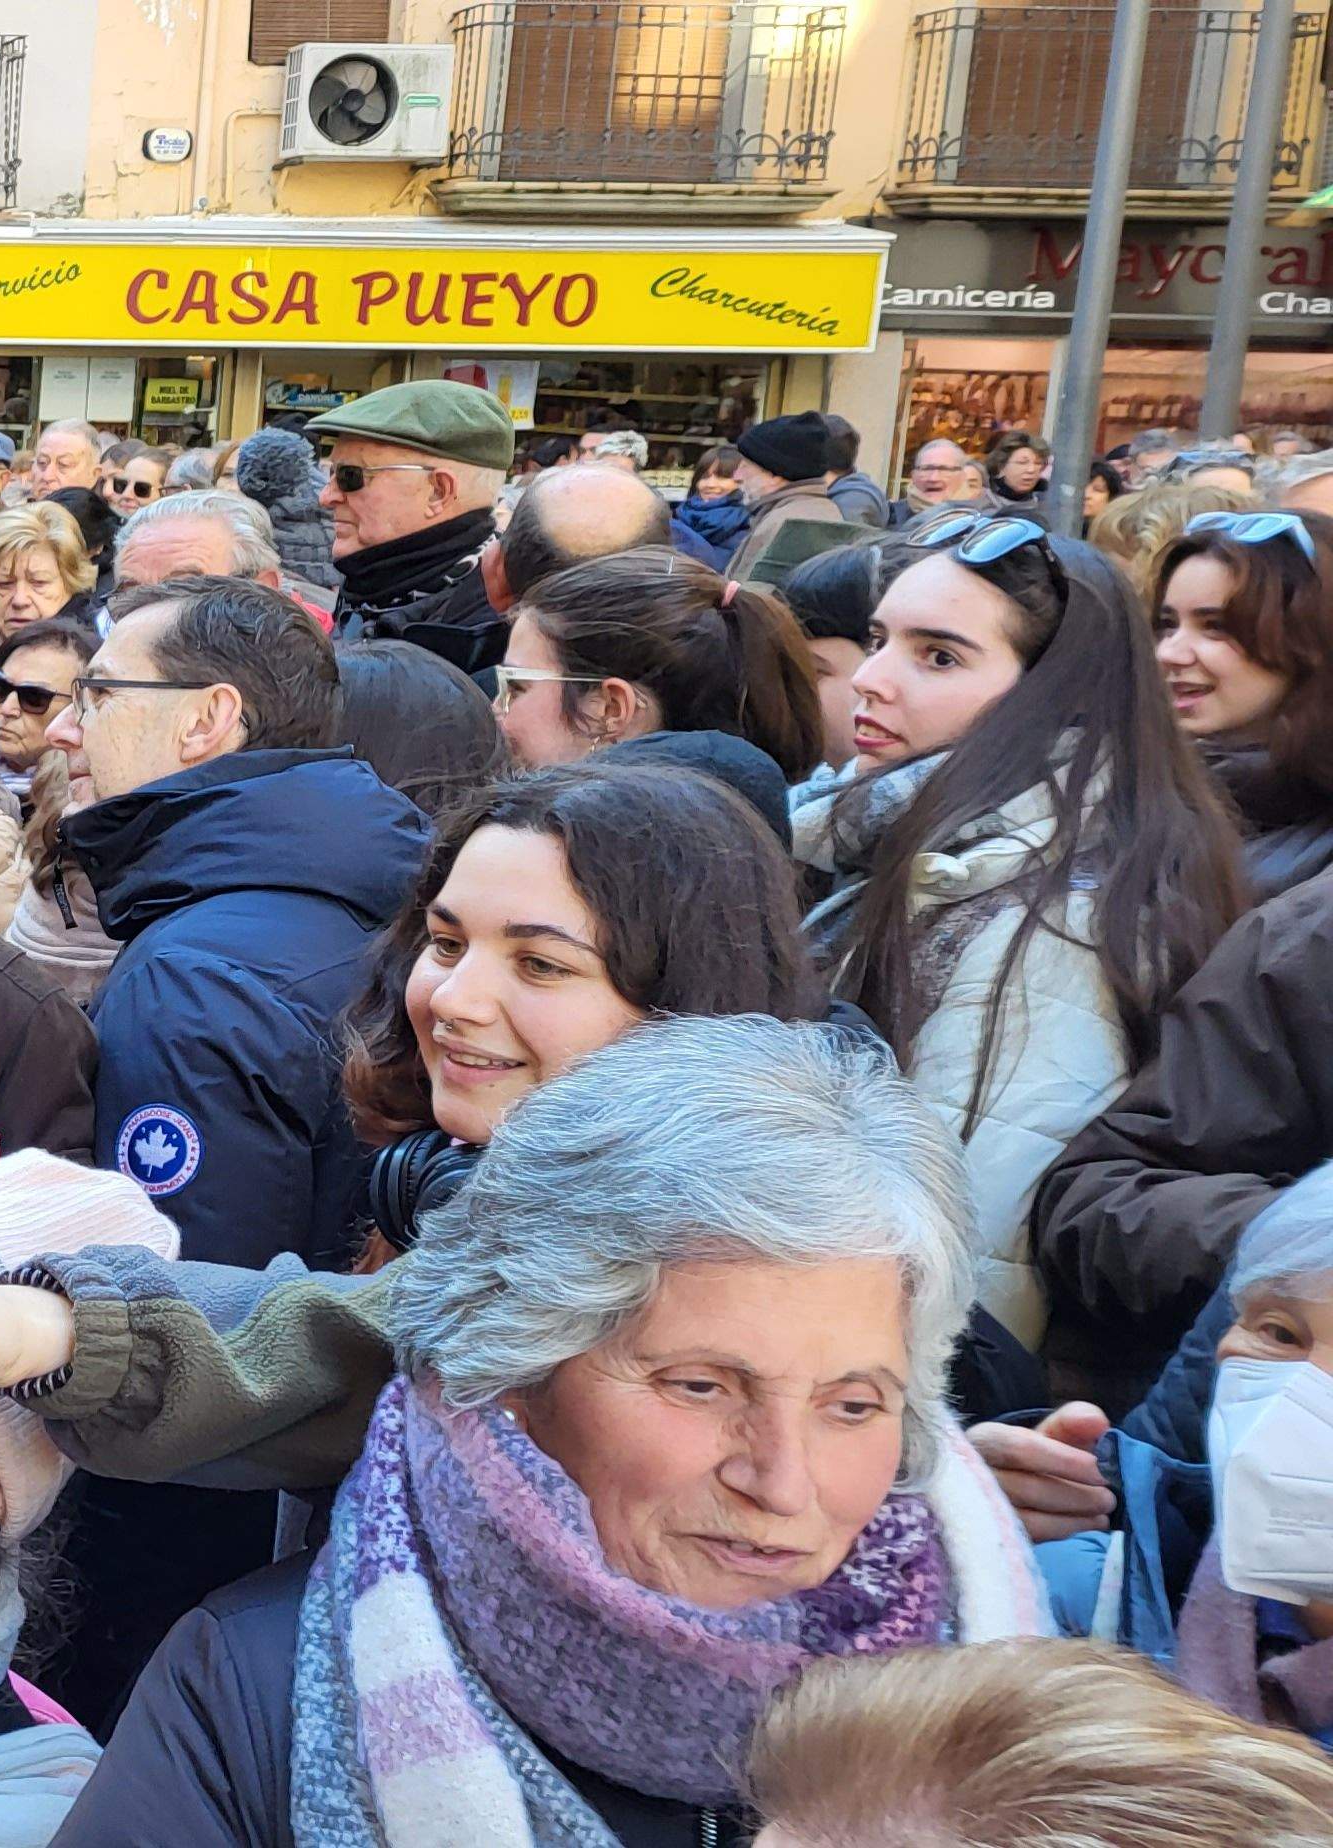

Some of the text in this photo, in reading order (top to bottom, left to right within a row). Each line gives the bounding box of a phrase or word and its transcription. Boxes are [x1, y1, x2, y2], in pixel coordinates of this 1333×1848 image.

[125, 268, 600, 328] CASA PUEYO
[1023, 225, 1333, 300] Mayoal
[649, 266, 841, 337] Charcutería
